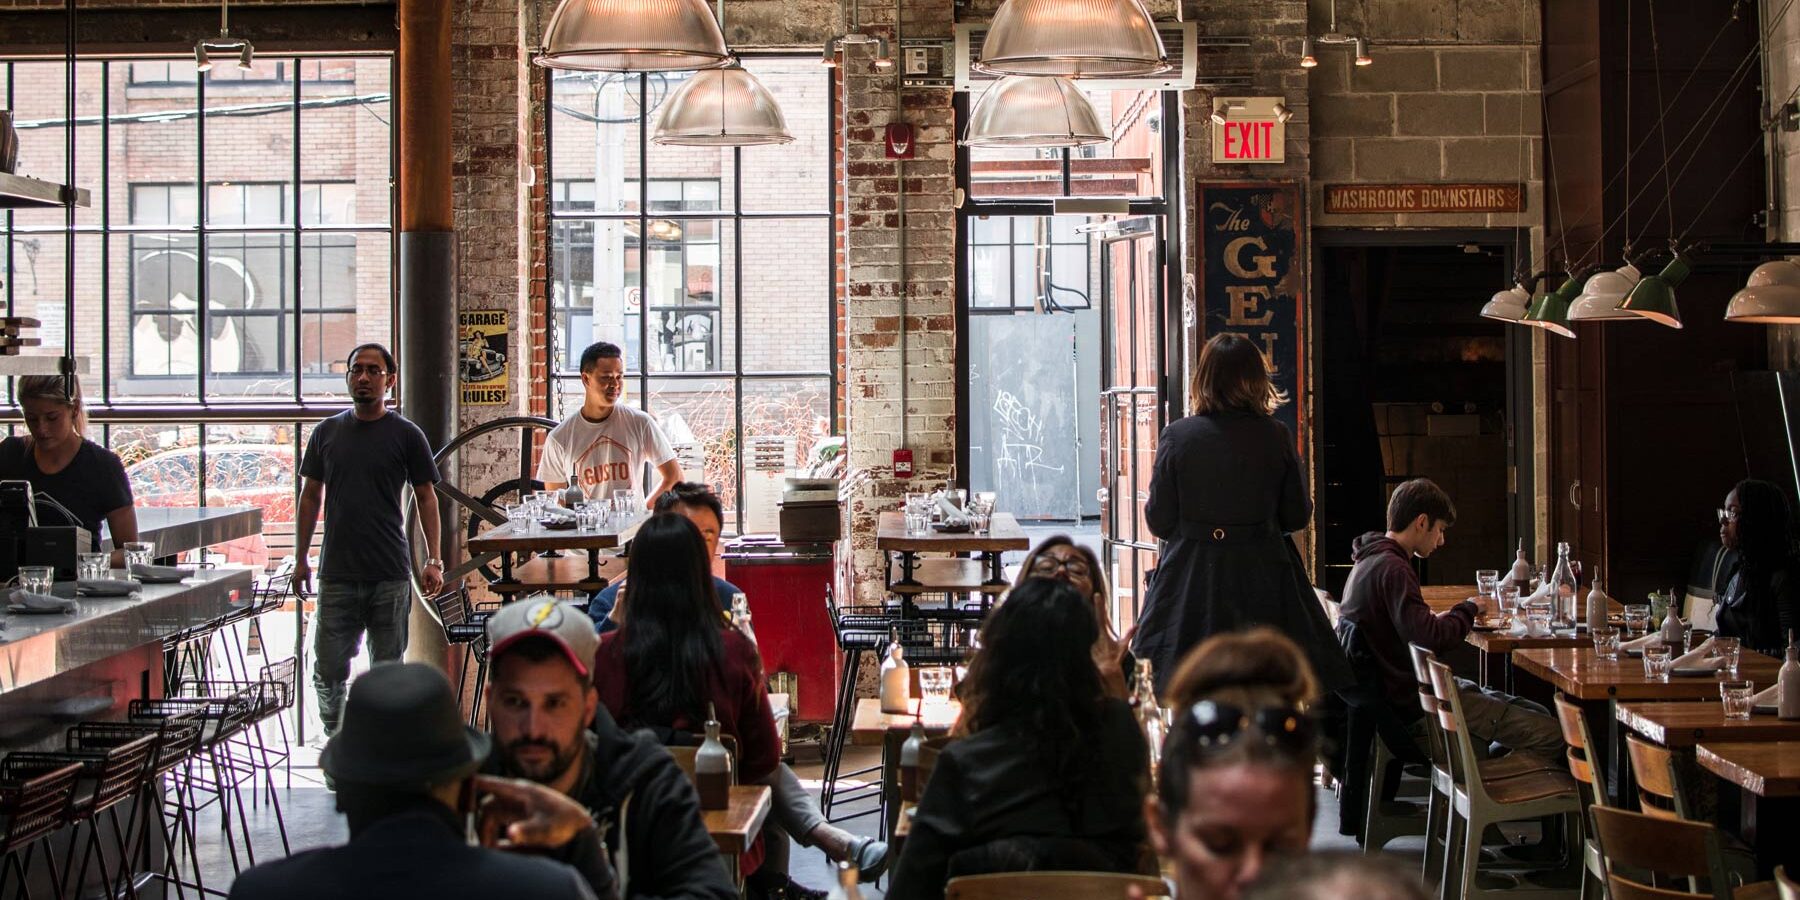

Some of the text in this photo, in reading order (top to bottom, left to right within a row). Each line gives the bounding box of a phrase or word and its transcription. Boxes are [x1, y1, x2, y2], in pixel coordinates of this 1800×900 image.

[1224, 122, 1274, 159] EXIT
[1331, 187, 1505, 209] WASHROOMS DOWNSTAIRS
[1209, 202, 1250, 232] The
[460, 313, 505, 326] GARAGE
[463, 390, 506, 403] RULES!
[584, 462, 629, 486] GUSTO
